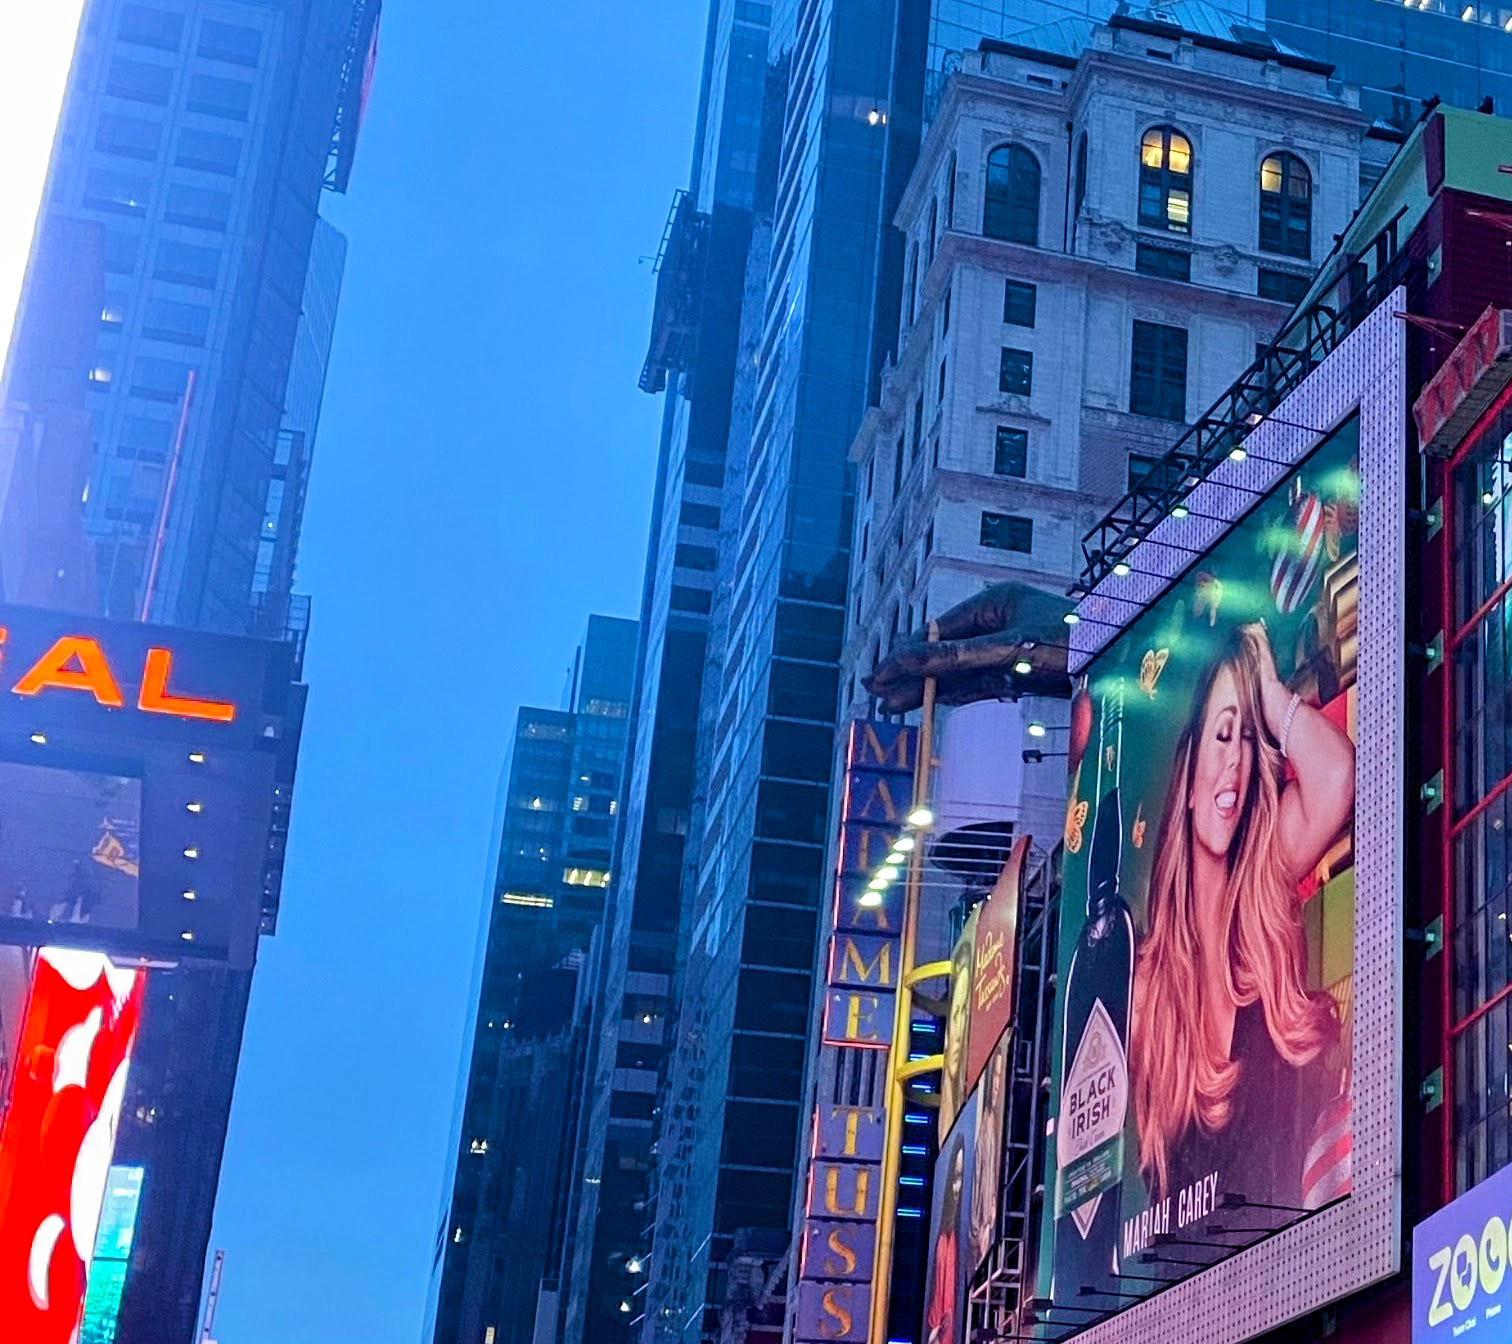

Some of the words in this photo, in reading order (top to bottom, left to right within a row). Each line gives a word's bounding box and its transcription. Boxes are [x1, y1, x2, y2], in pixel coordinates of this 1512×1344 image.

[0, 625, 235, 722] AL
[1069, 1066, 1115, 1116] BLACK
[1072, 1096, 1111, 1139] IRISH
[1124, 1197, 1171, 1259] MARIAH
[1178, 1171, 1218, 1229] CAREY
